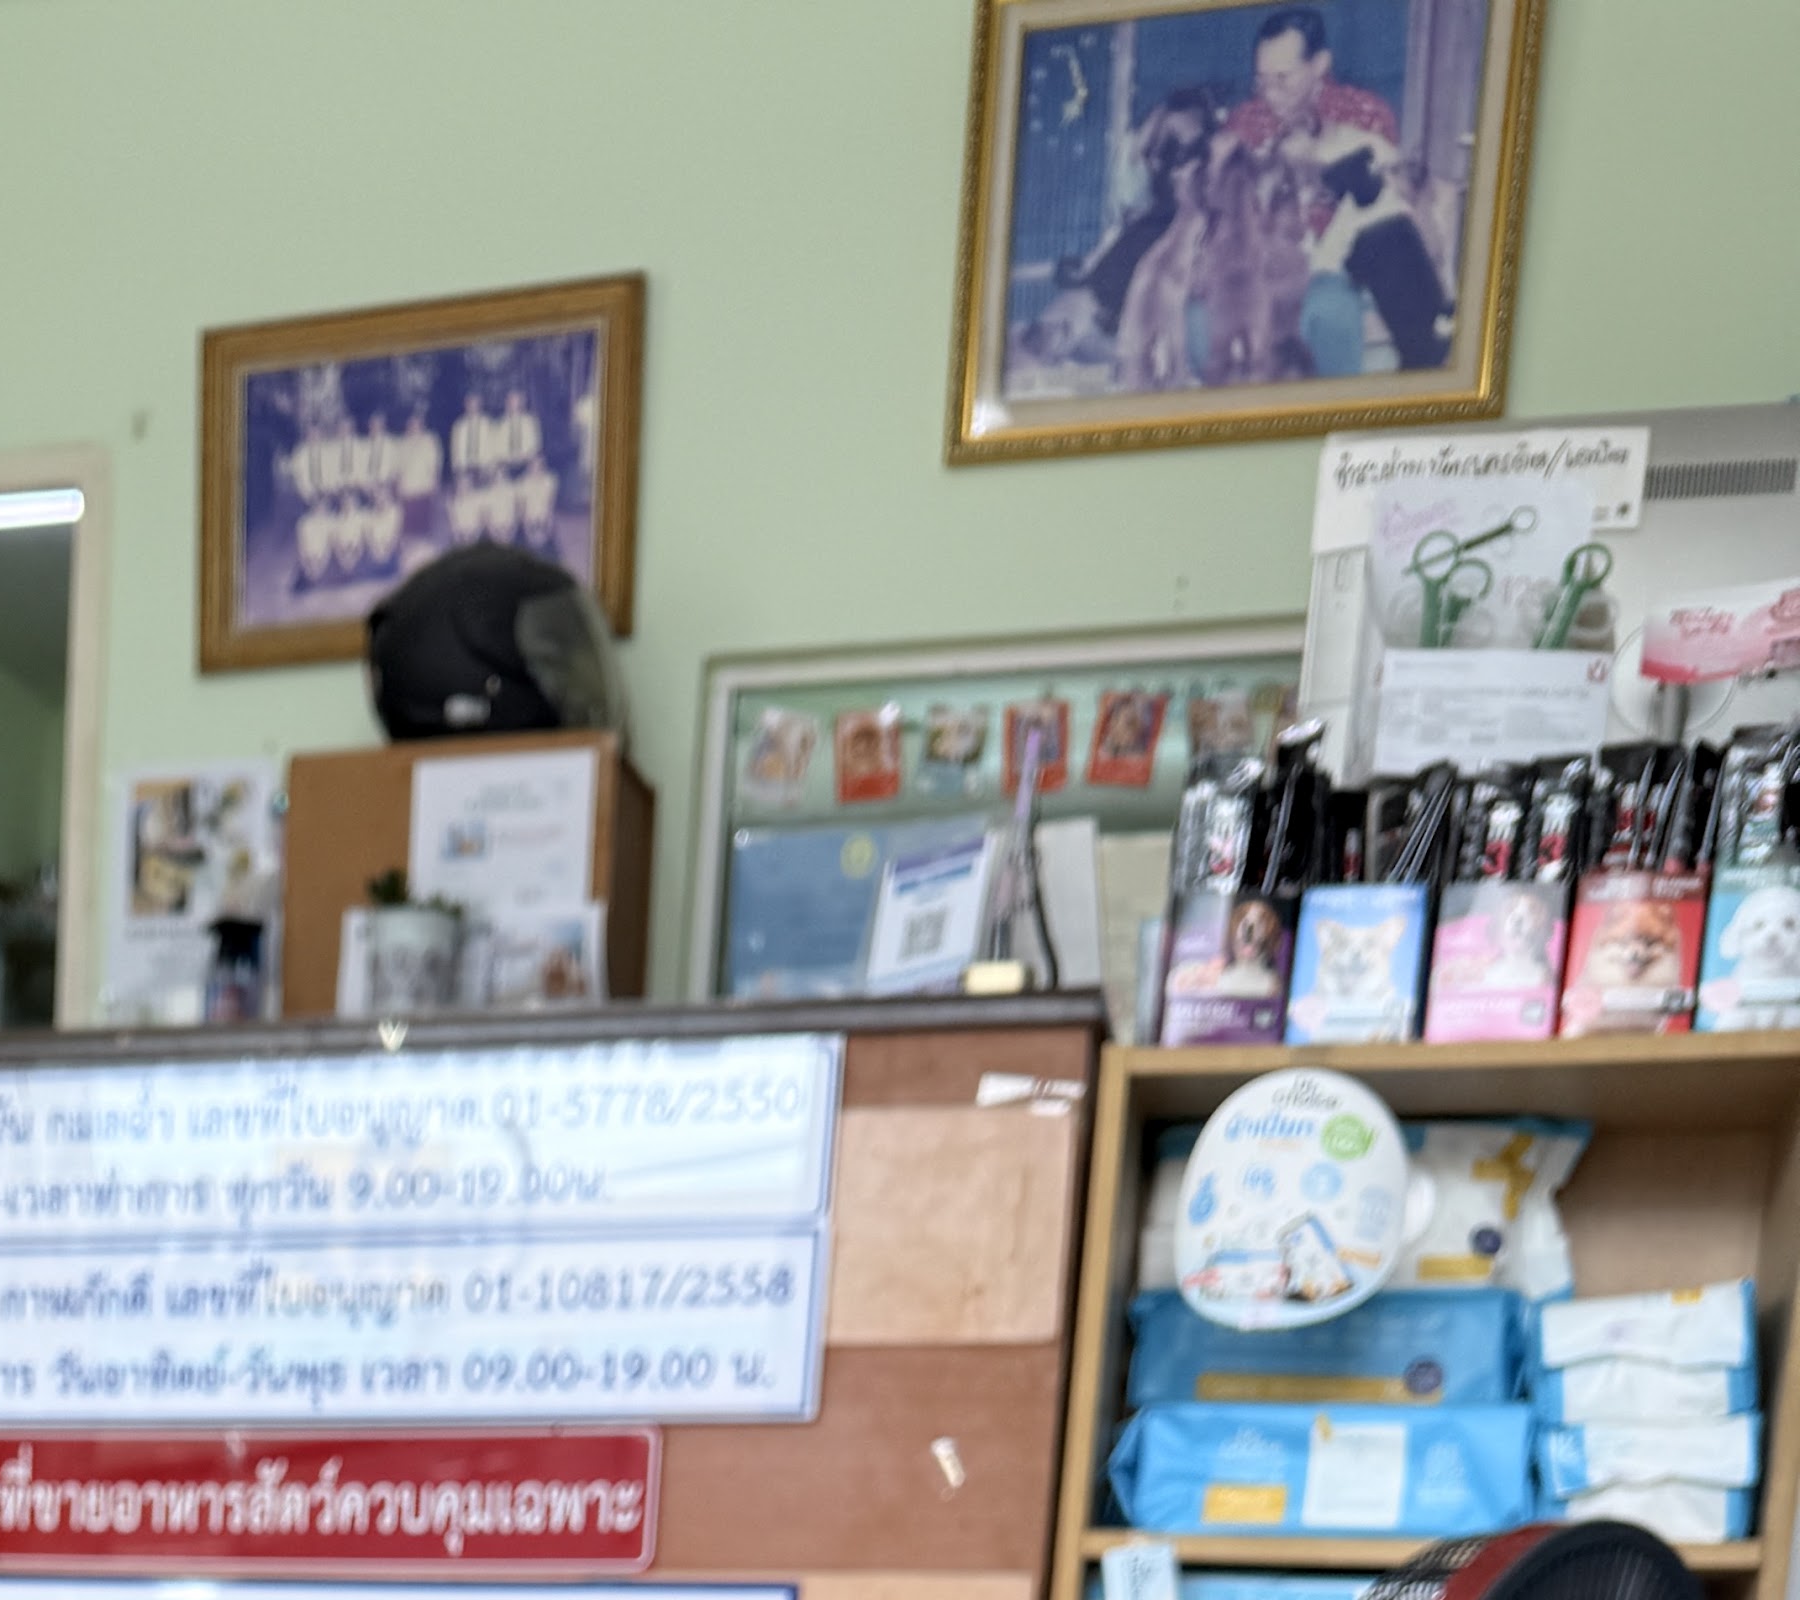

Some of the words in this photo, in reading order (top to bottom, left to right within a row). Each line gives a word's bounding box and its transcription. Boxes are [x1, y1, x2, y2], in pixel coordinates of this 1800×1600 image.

[463, 1264, 795, 1314] 01-10817/2558
[361, 1356, 450, 1393] เวลา
[462, 1347, 714, 1392] 09.00-19.00
